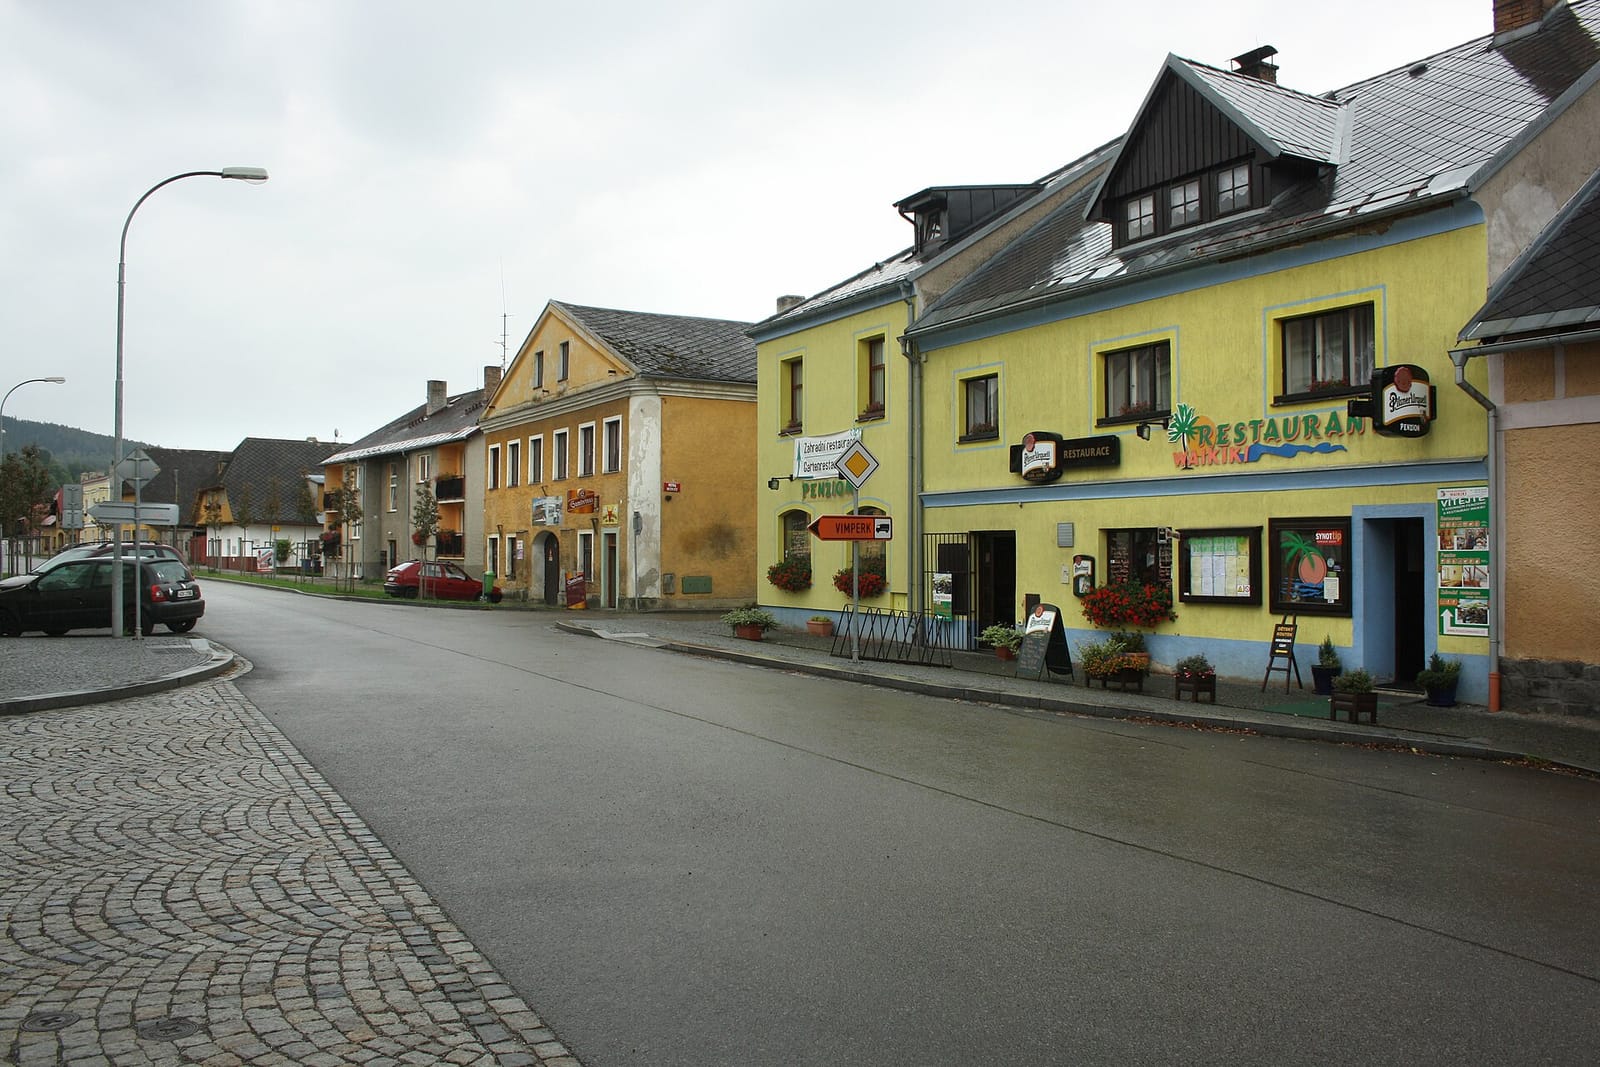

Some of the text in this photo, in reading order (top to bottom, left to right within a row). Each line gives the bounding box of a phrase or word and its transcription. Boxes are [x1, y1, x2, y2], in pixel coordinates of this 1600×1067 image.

[1198, 410, 1368, 447] RESTAURAN
[1063, 446, 1110, 459] RESTAURACE
[1172, 445, 1250, 466] WAIKIKI
[835, 522, 871, 534] VIMPERK
